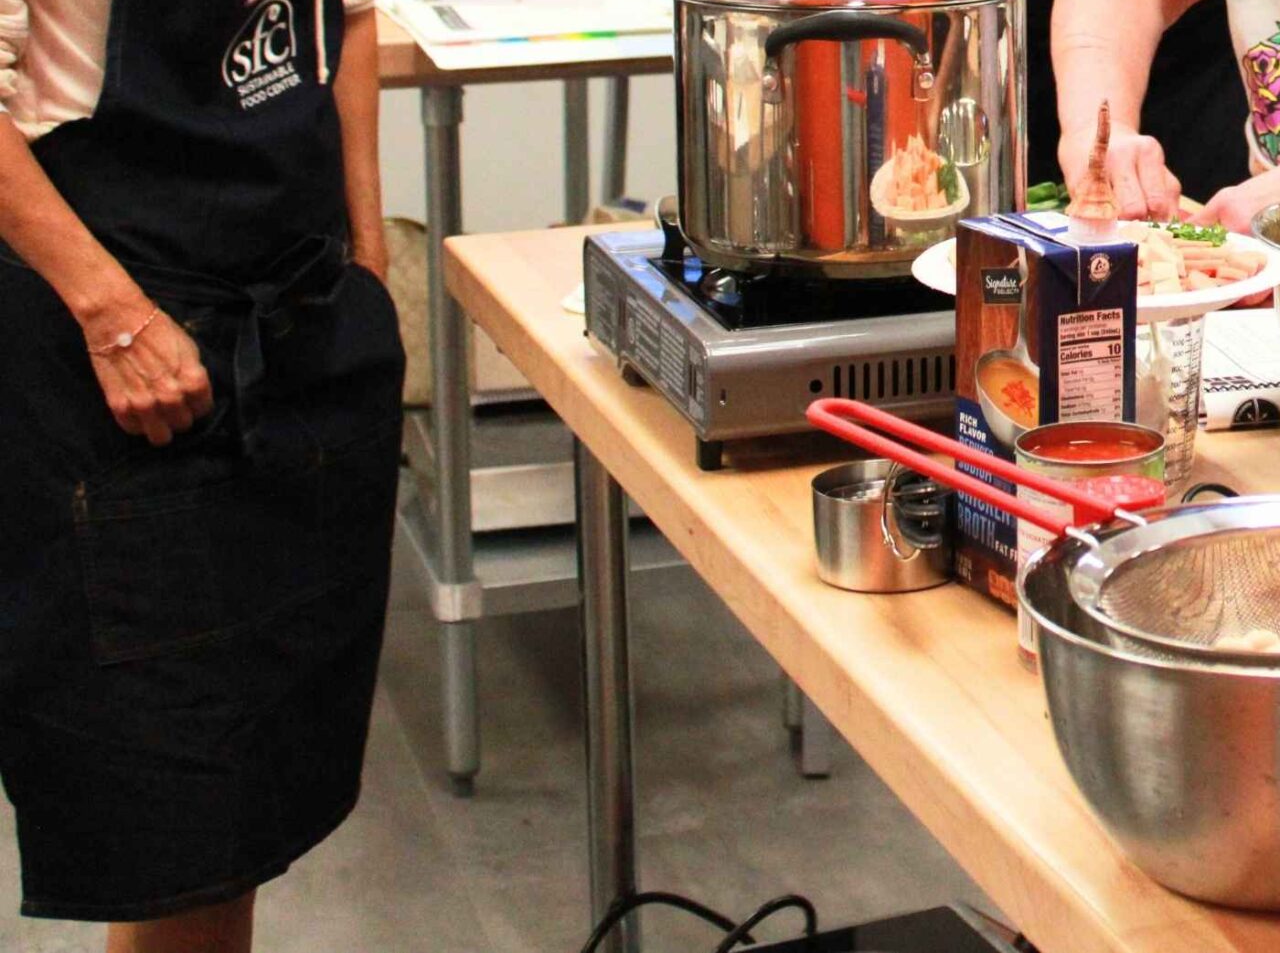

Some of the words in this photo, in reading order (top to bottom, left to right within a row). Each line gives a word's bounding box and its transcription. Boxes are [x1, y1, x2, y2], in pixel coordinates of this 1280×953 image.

[1060, 313, 1095, 325] Nutrition
[1096, 311, 1120, 321] Facts
[1060, 349, 1093, 361] Calories
[1107, 343, 1121, 355] 10
[959, 411, 978, 428] RICH
[959, 422, 987, 444] FLAVOR
[957, 503, 996, 550] BROTH
[994, 540, 1008, 558] FAT
